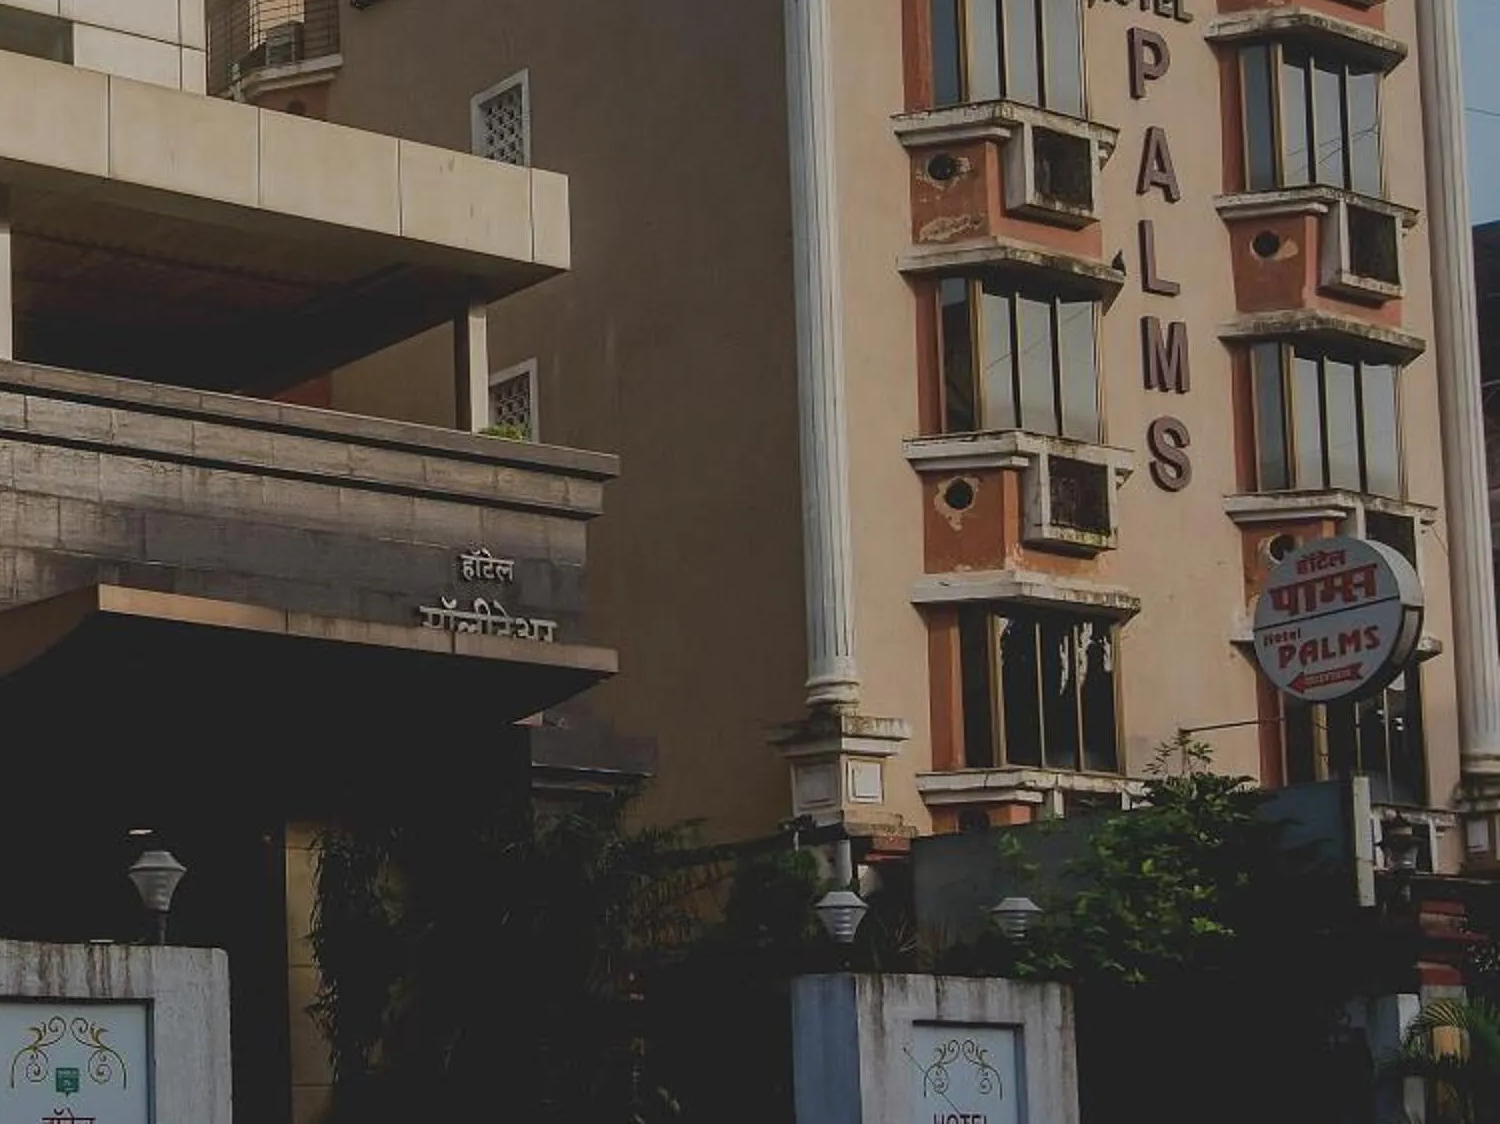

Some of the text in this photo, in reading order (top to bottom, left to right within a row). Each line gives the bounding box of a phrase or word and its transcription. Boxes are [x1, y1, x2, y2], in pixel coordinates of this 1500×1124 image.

[1126, 26, 1193, 492] PALMS
[460, 547, 515, 582] हॉटेल
[1277, 625, 1382, 669] PALMS
